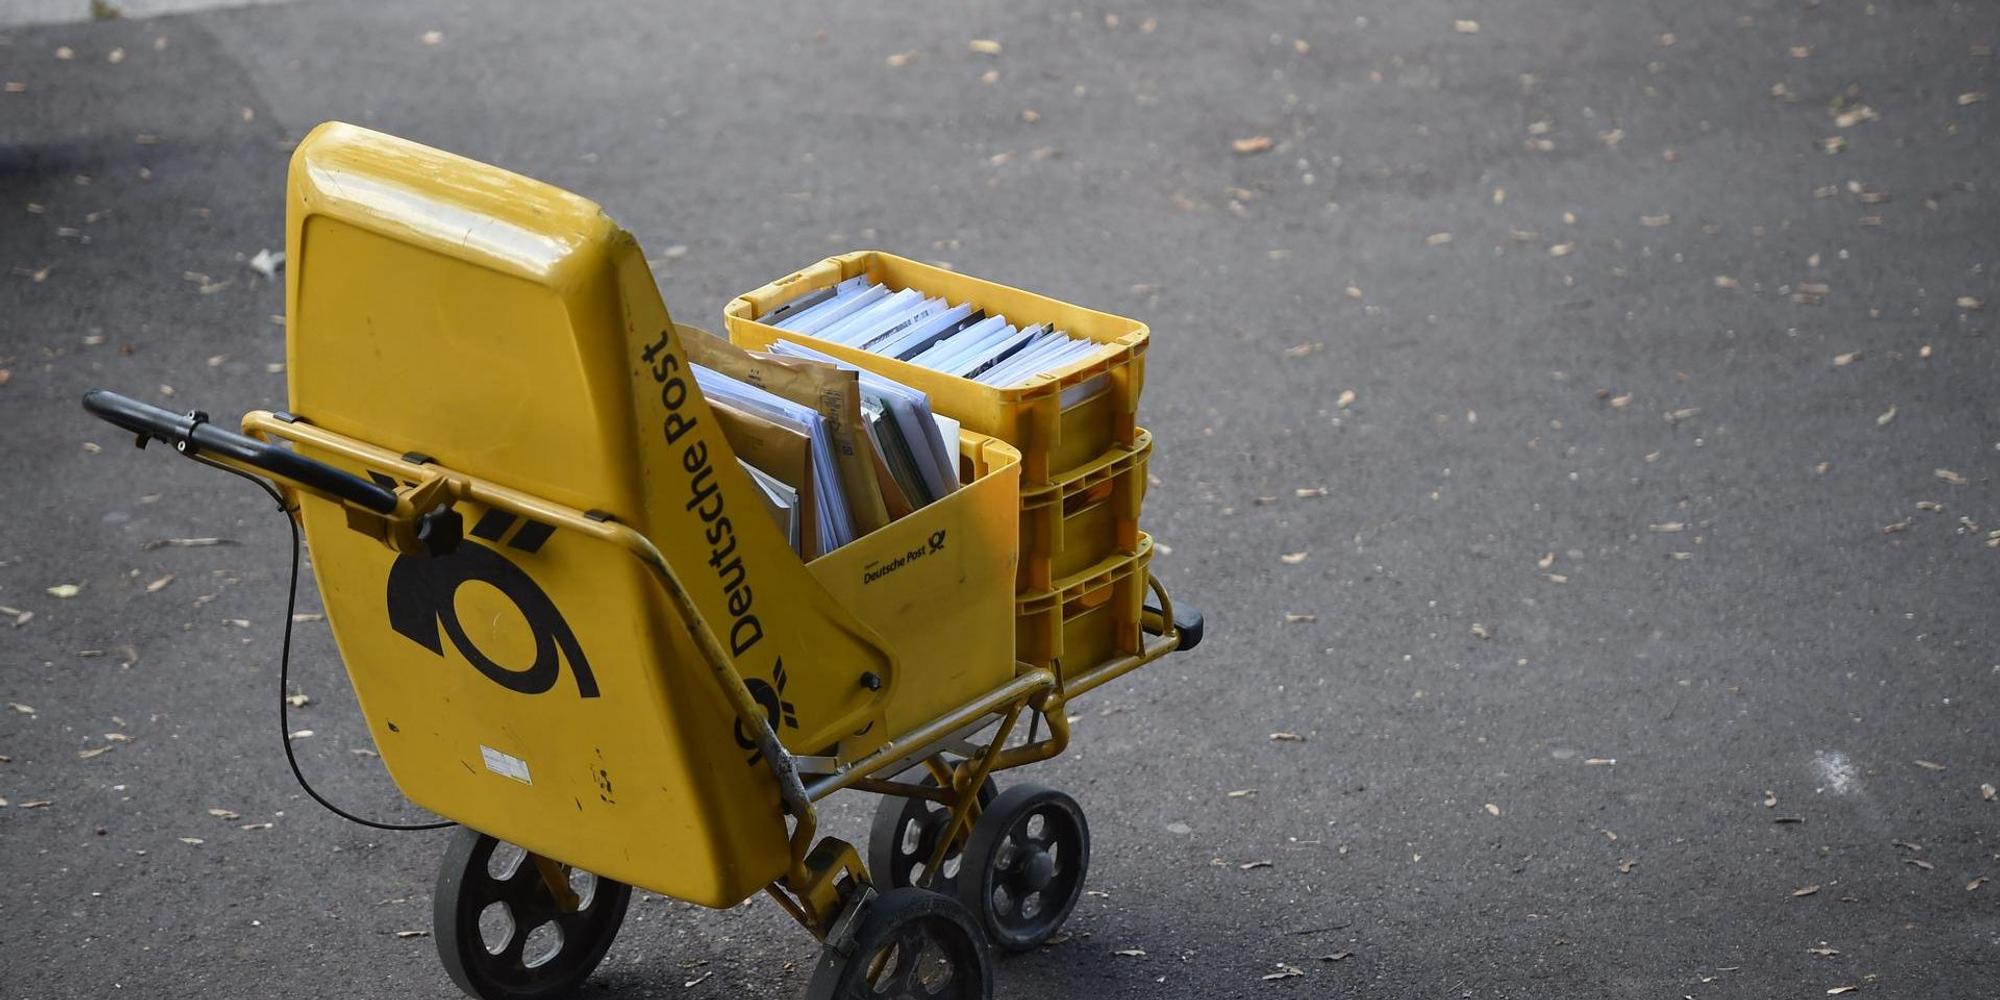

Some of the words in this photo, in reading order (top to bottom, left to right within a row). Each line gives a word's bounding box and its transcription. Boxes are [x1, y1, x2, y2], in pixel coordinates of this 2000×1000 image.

[641, 330, 698, 446] Post
[682, 439, 764, 659] Deutsche
[863, 557, 906, 585] Deutsche
[906, 545, 926, 564] Post
